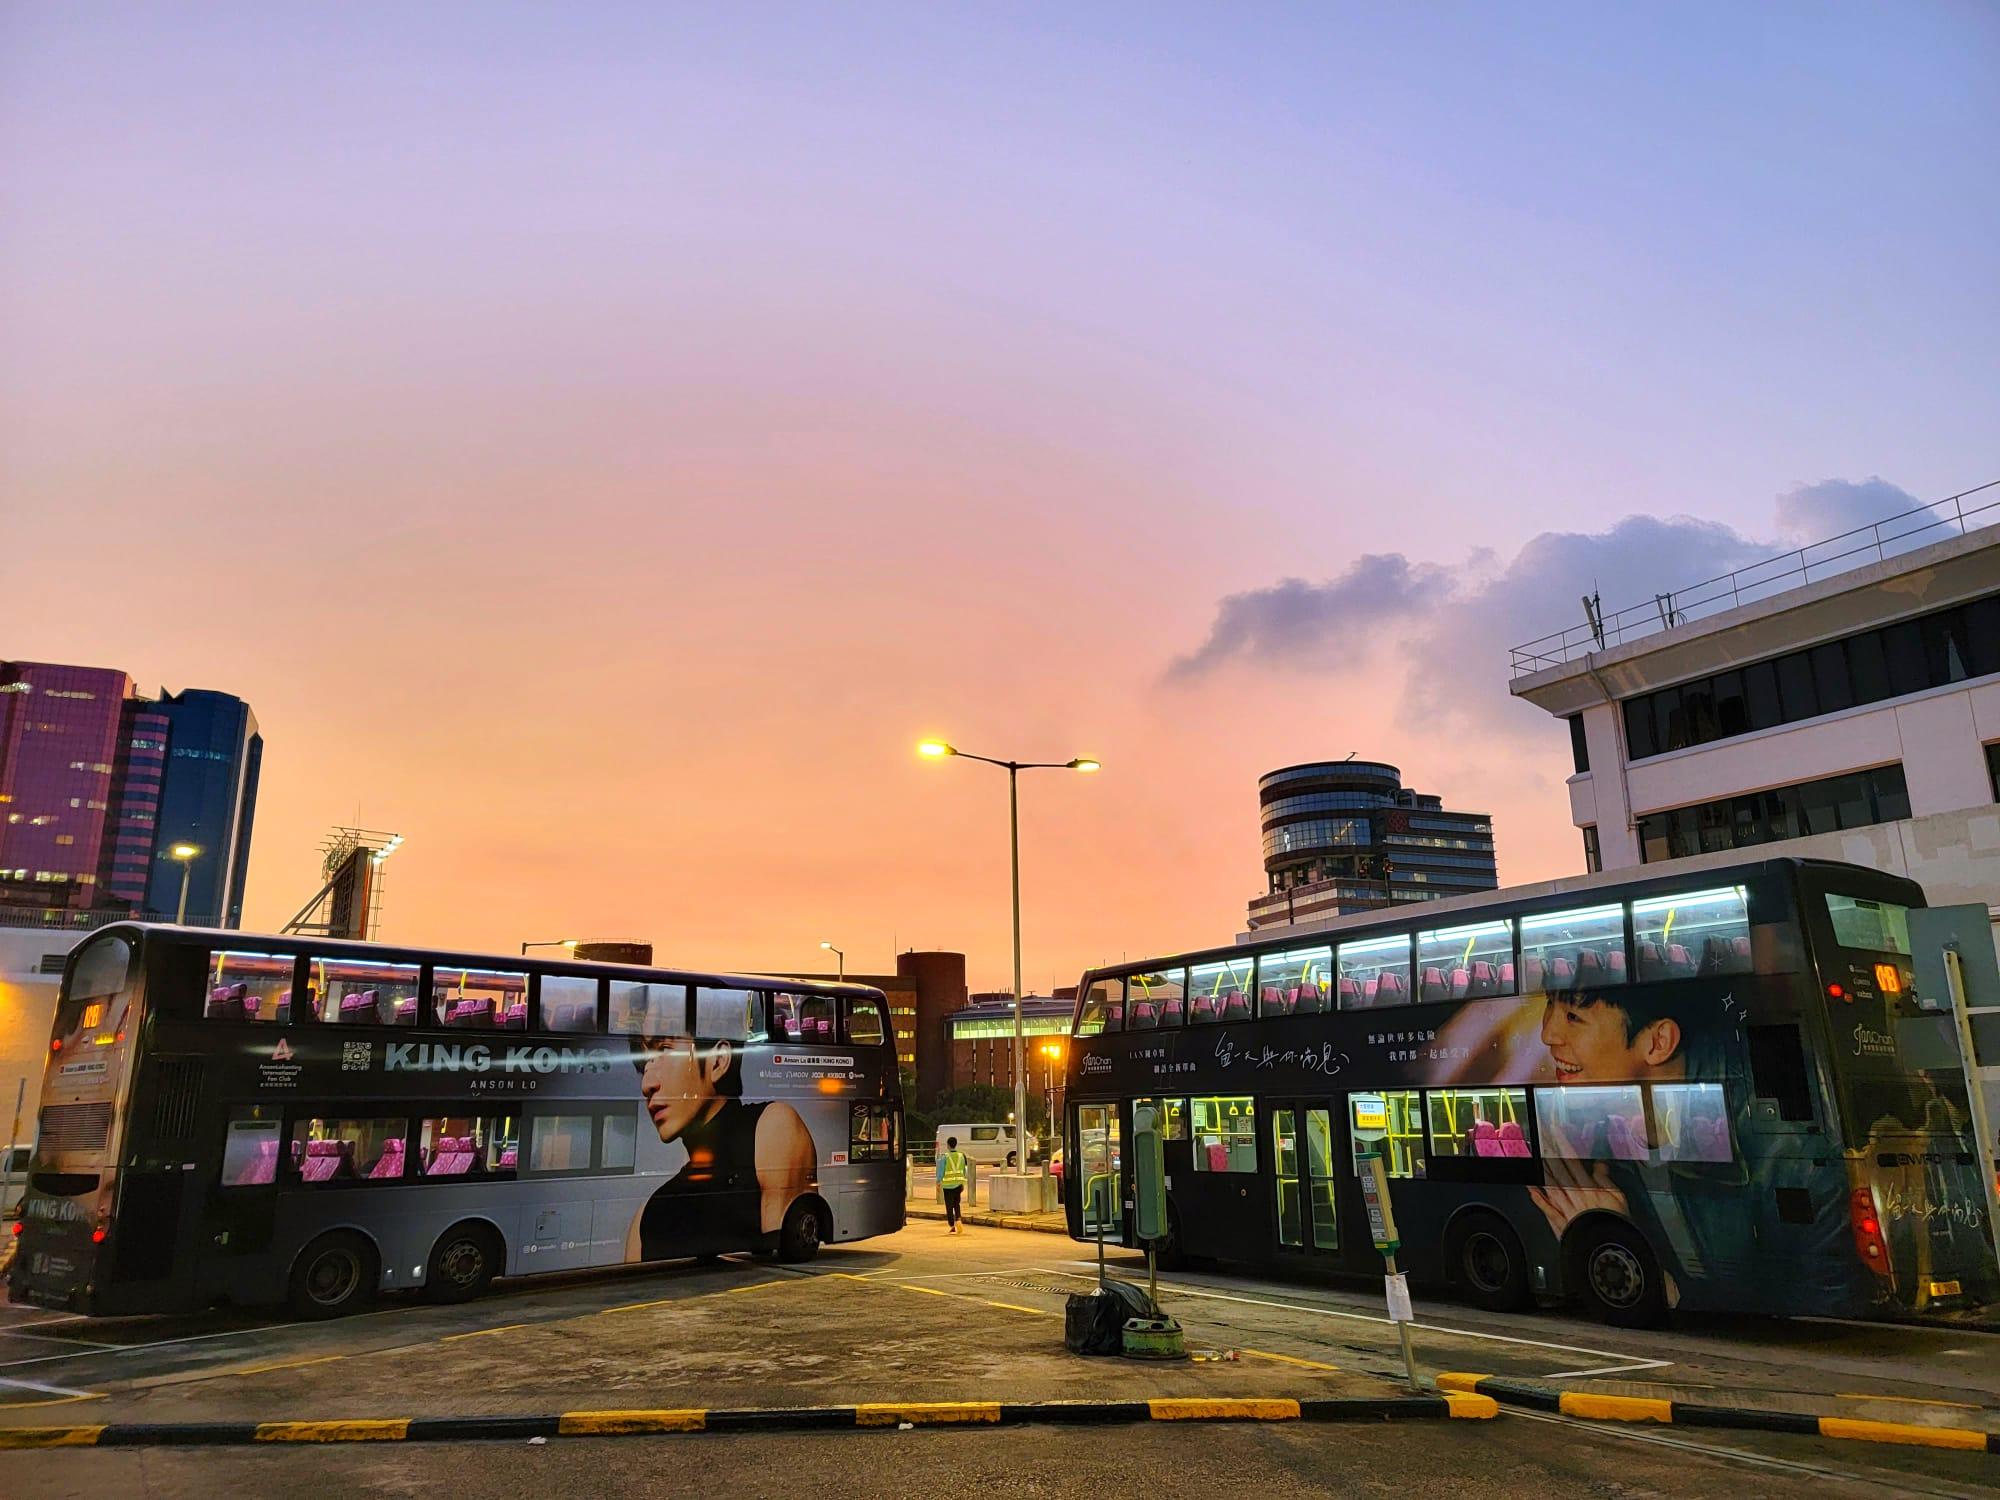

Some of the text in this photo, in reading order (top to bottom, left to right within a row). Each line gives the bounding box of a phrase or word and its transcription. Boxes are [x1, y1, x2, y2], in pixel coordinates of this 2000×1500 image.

[384, 1042, 611, 1074] KING KONG
[470, 1080, 537, 1090] ANSON LO
[28, 1199, 57, 1218] KING
